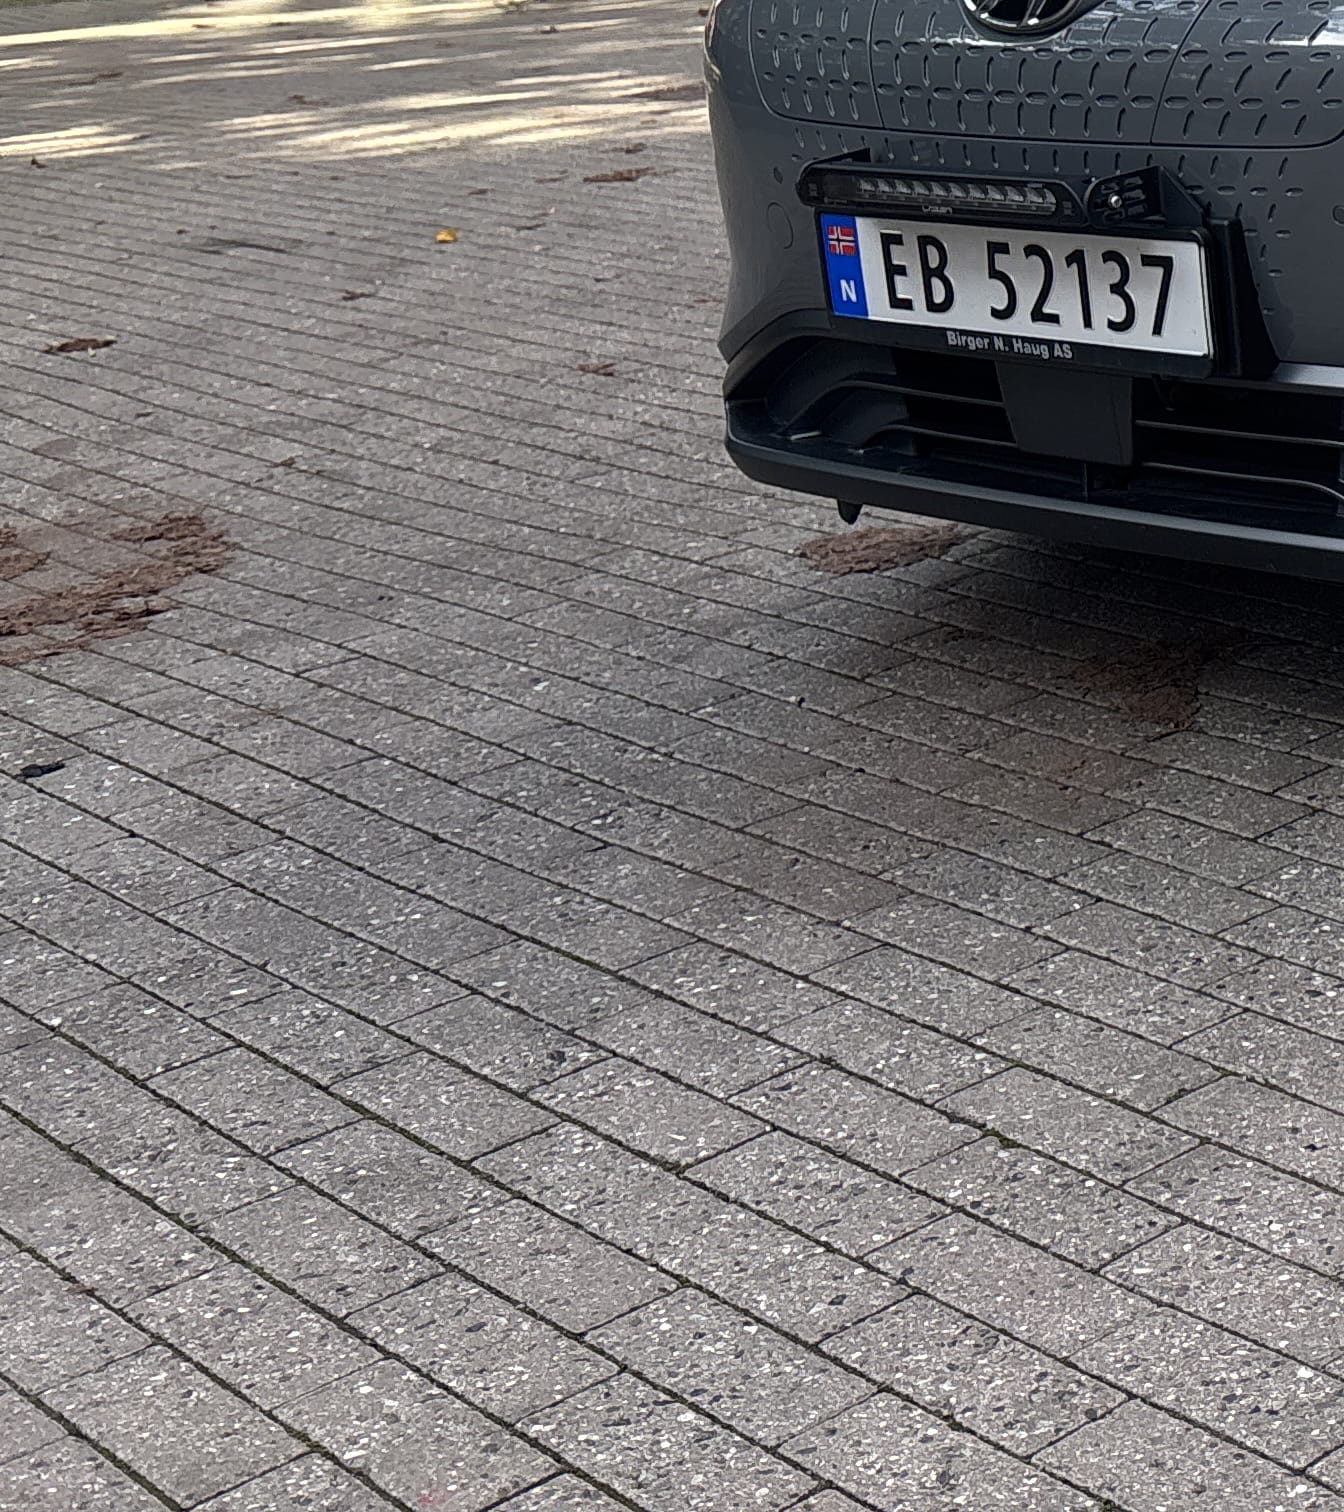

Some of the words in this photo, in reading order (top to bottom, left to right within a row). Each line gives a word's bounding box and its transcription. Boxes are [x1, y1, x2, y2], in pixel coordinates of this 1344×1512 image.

[840, 279, 858, 303] N
[880, 231, 955, 313] EB
[986, 240, 1175, 337] 52137
[946, 330, 990, 351] Birger
[993, 335, 1009, 352] N.
[1012, 338, 1050, 360] Haug
[1053, 343, 1073, 359] AS
